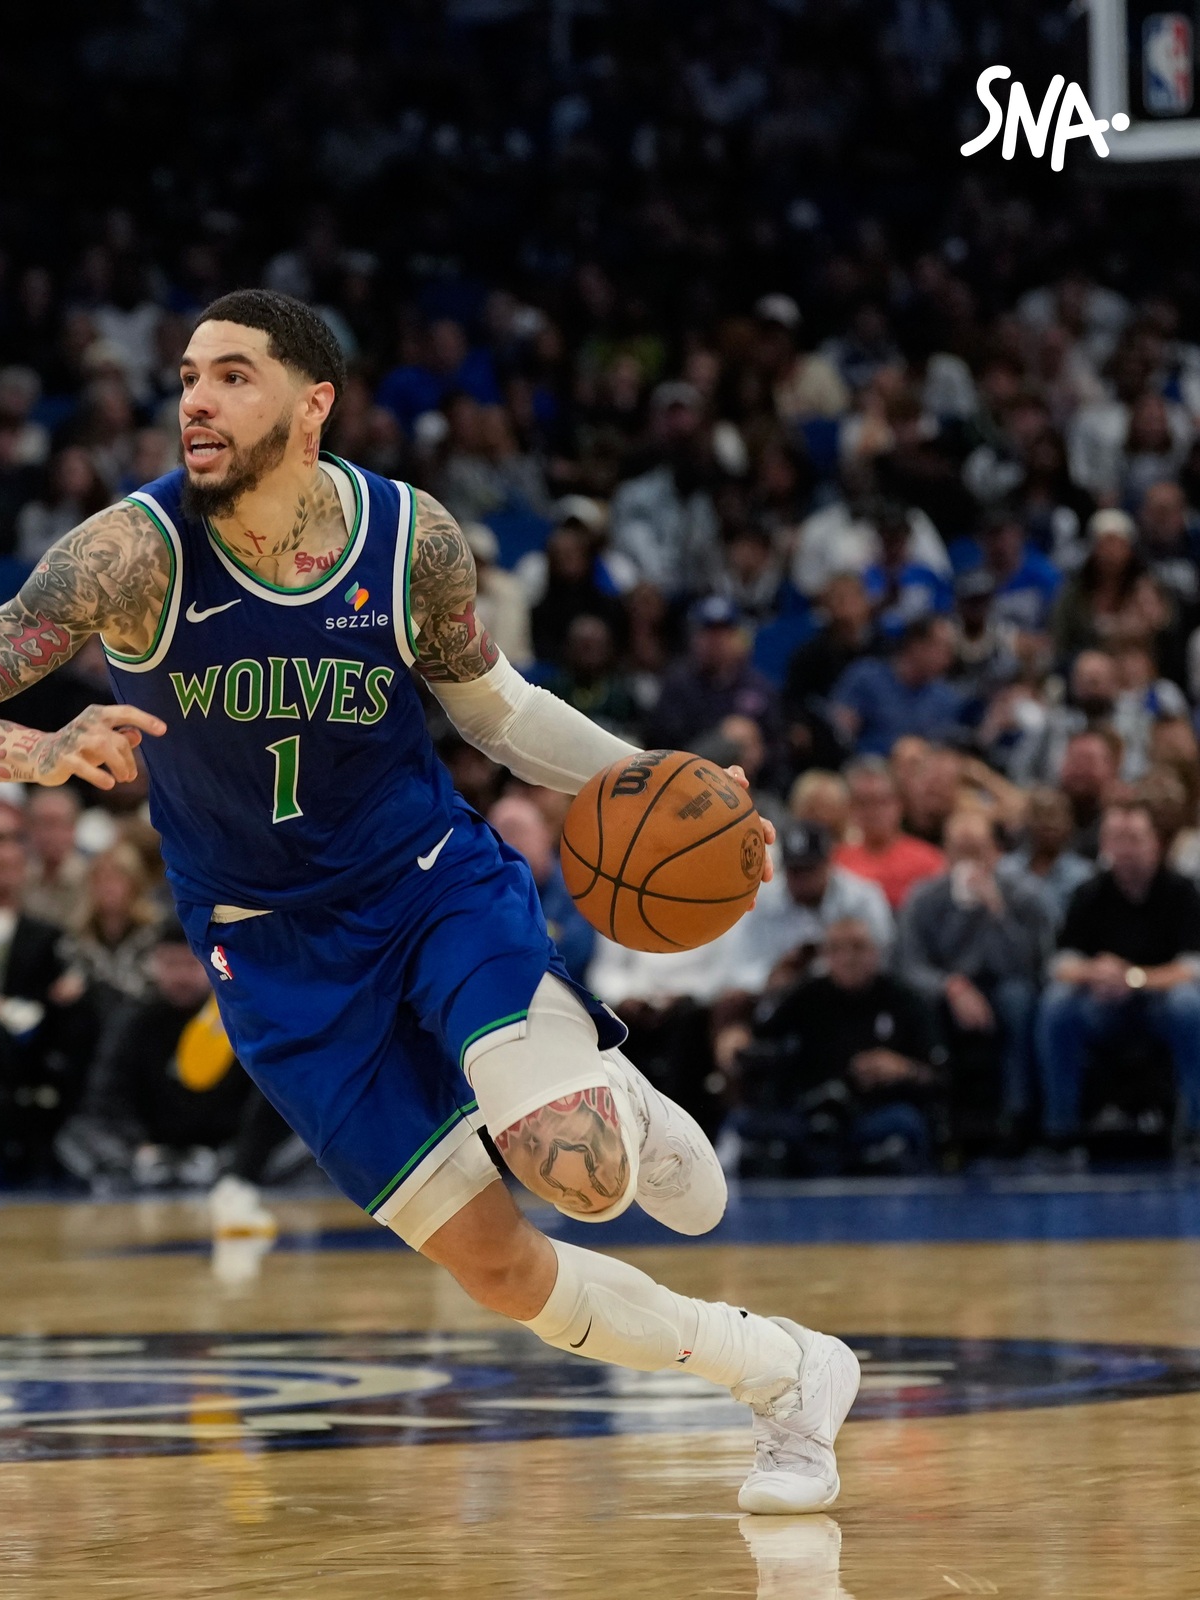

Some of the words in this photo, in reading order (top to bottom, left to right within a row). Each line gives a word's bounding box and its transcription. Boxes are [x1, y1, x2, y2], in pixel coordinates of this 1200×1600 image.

[325, 610, 389, 630] sezzle
[168, 656, 395, 726] WOLVES
[265, 734, 304, 824] 1
